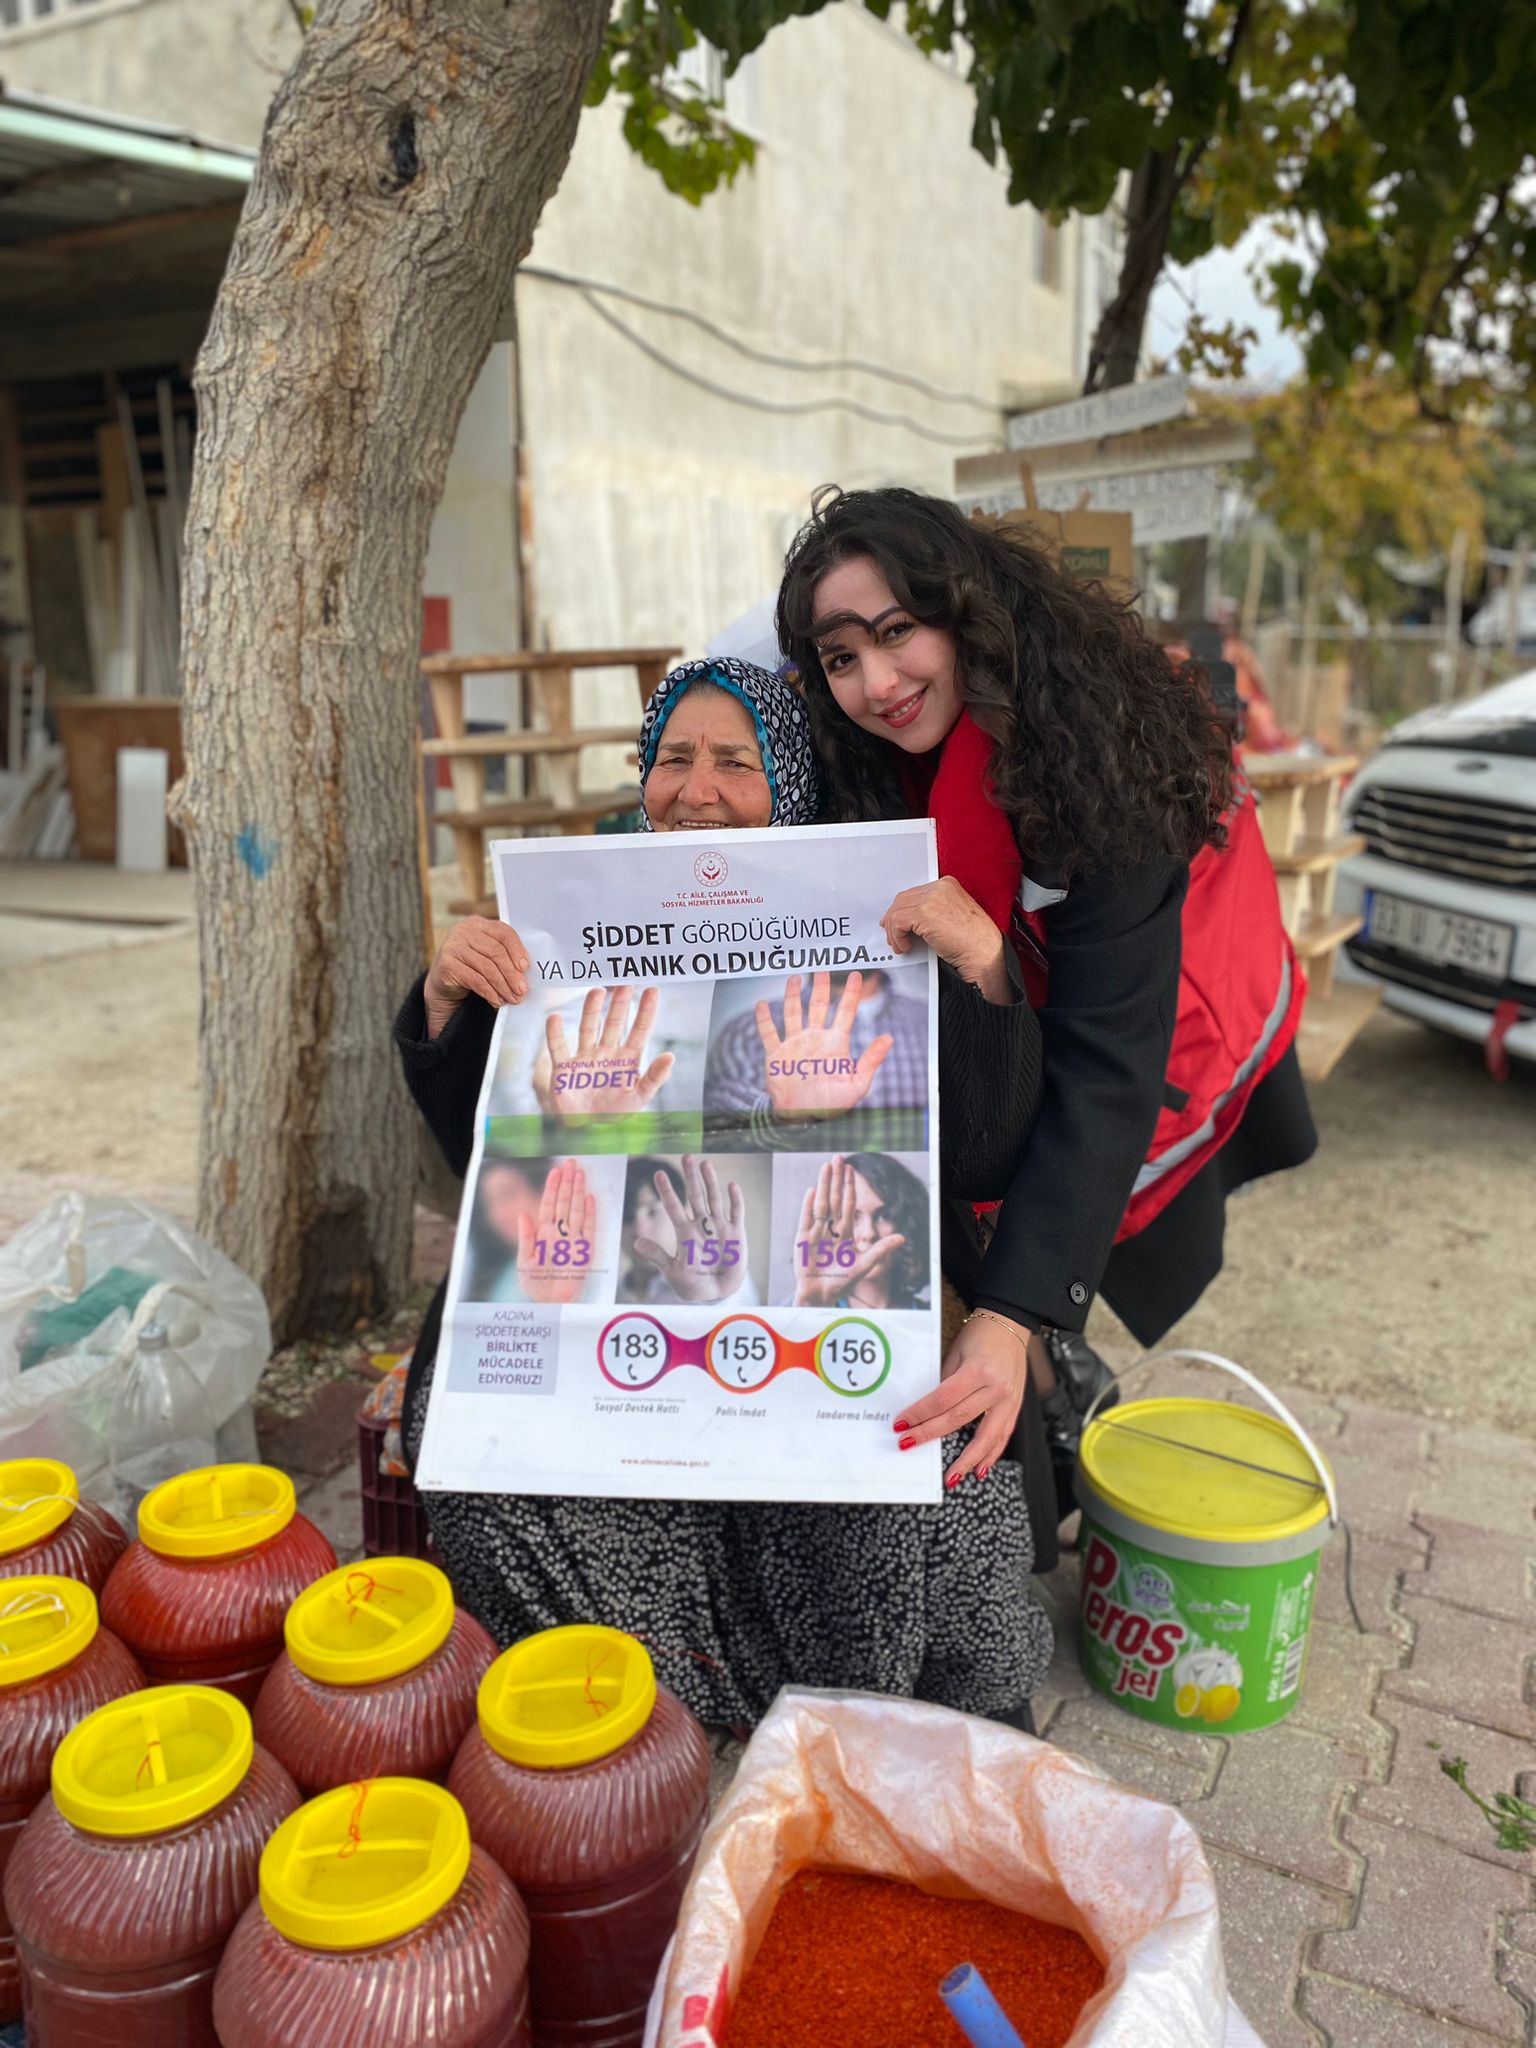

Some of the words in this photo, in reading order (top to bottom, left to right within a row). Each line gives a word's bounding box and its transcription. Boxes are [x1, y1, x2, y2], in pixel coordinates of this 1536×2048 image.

[688, 898, 726, 907] HİZMETLER
[727, 895, 764, 905] BAKANLIĞI
[708, 890, 738, 899] ÇALIŞMA
[740, 889, 748, 897] VE
[582, 921, 675, 954] ŞİDDET
[682, 916, 851, 944] GÖRDÜĞÜMDE
[537, 960, 564, 980] YA
[571, 959, 602, 980] DA
[607, 954, 686, 978] TANIK
[692, 945, 894, 975] OLDUĞUMDA...
[596, 1057, 638, 1068] YÖNELİK
[769, 1058, 858, 1080] SUÇTUR!
[555, 1068, 639, 1095] ŞİDDET
[535, 1239, 591, 1266] 183
[681, 1239, 741, 1267] 155
[797, 1239, 857, 1268] 156
[493, 1310, 534, 1321] KADINA
[475, 1325, 521, 1338] ŞİDDETE
[521, 1326, 552, 1340] KARŞI
[486, 1340, 538, 1353] BİRLİKTE
[610, 1333, 658, 1358] 183
[717, 1336, 767, 1361] 155
[826, 1338, 876, 1364] 156
[478, 1355, 544, 1369] MÜCADELE
[478, 1371, 543, 1385] EDİYORUZ!
[625, 1402, 653, 1413] Destek
[715, 1406, 737, 1417] Polis
[1114, 1659, 1159, 1698] jel
